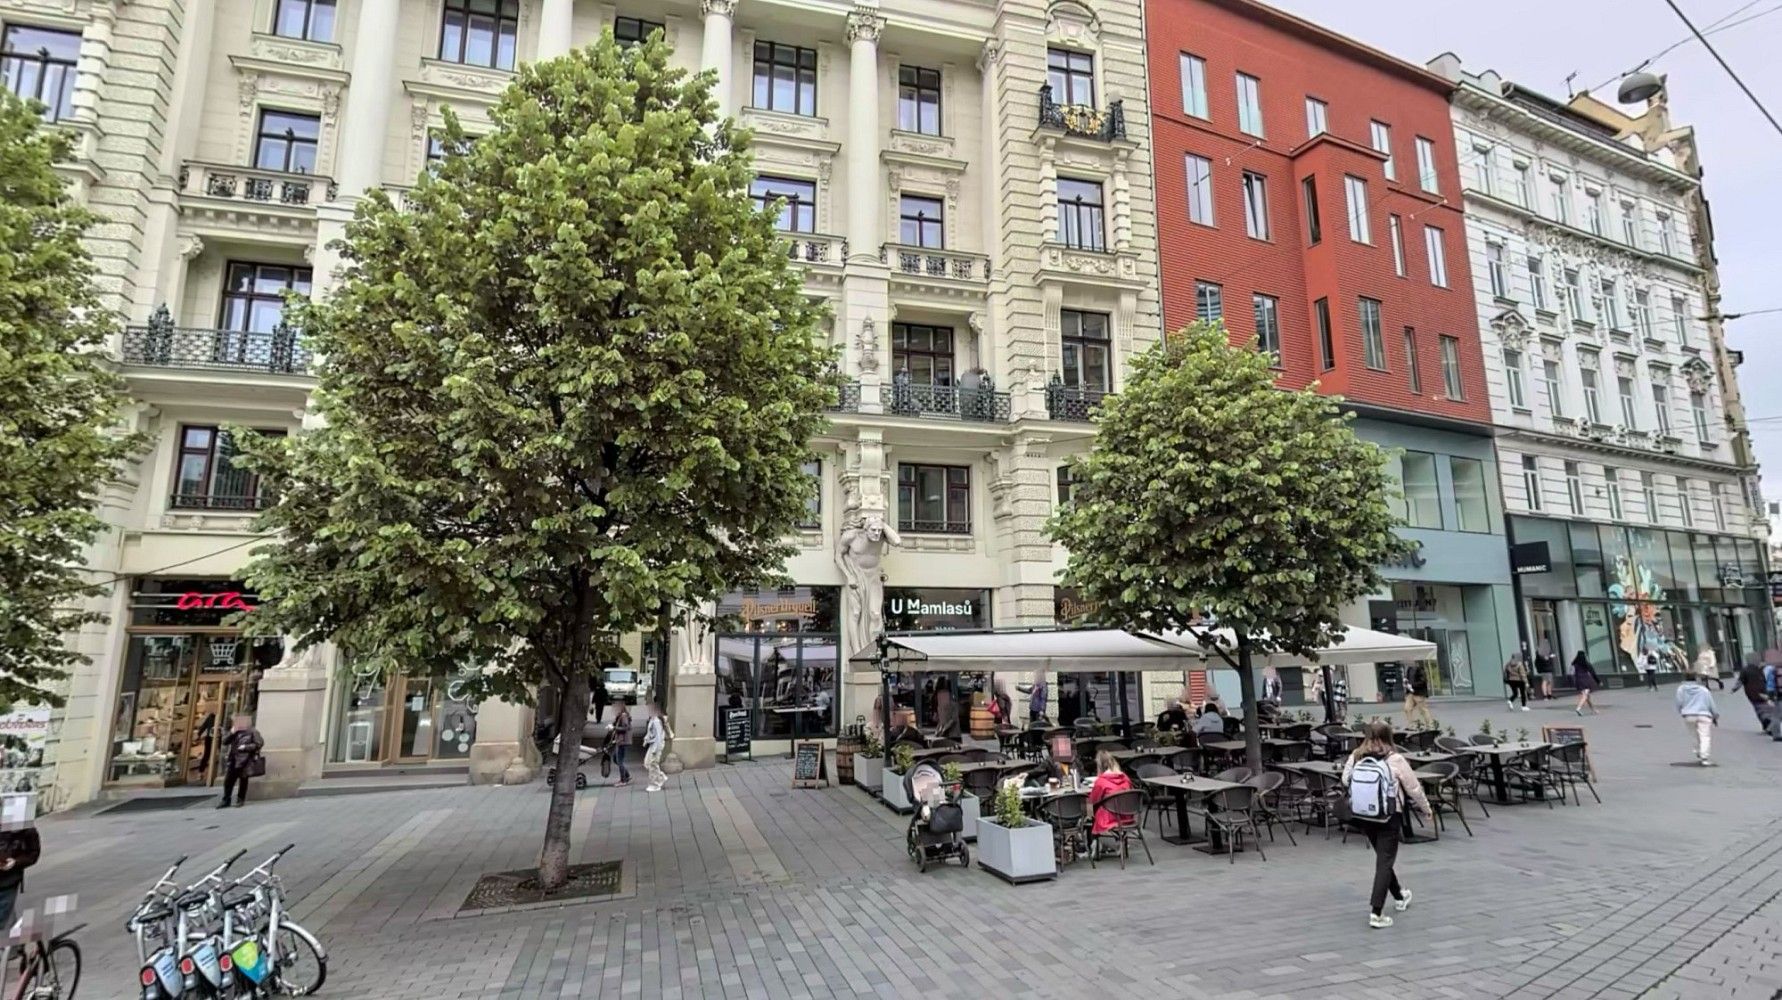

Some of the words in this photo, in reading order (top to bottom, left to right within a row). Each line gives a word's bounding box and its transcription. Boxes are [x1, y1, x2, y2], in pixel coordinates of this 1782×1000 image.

[1517, 565, 1547, 573] HUMANIC
[176, 591, 256, 612] ara
[741, 598, 780, 621] Pilsner
[891, 598, 903, 614] U
[907, 598, 972, 615] Mamlasů
